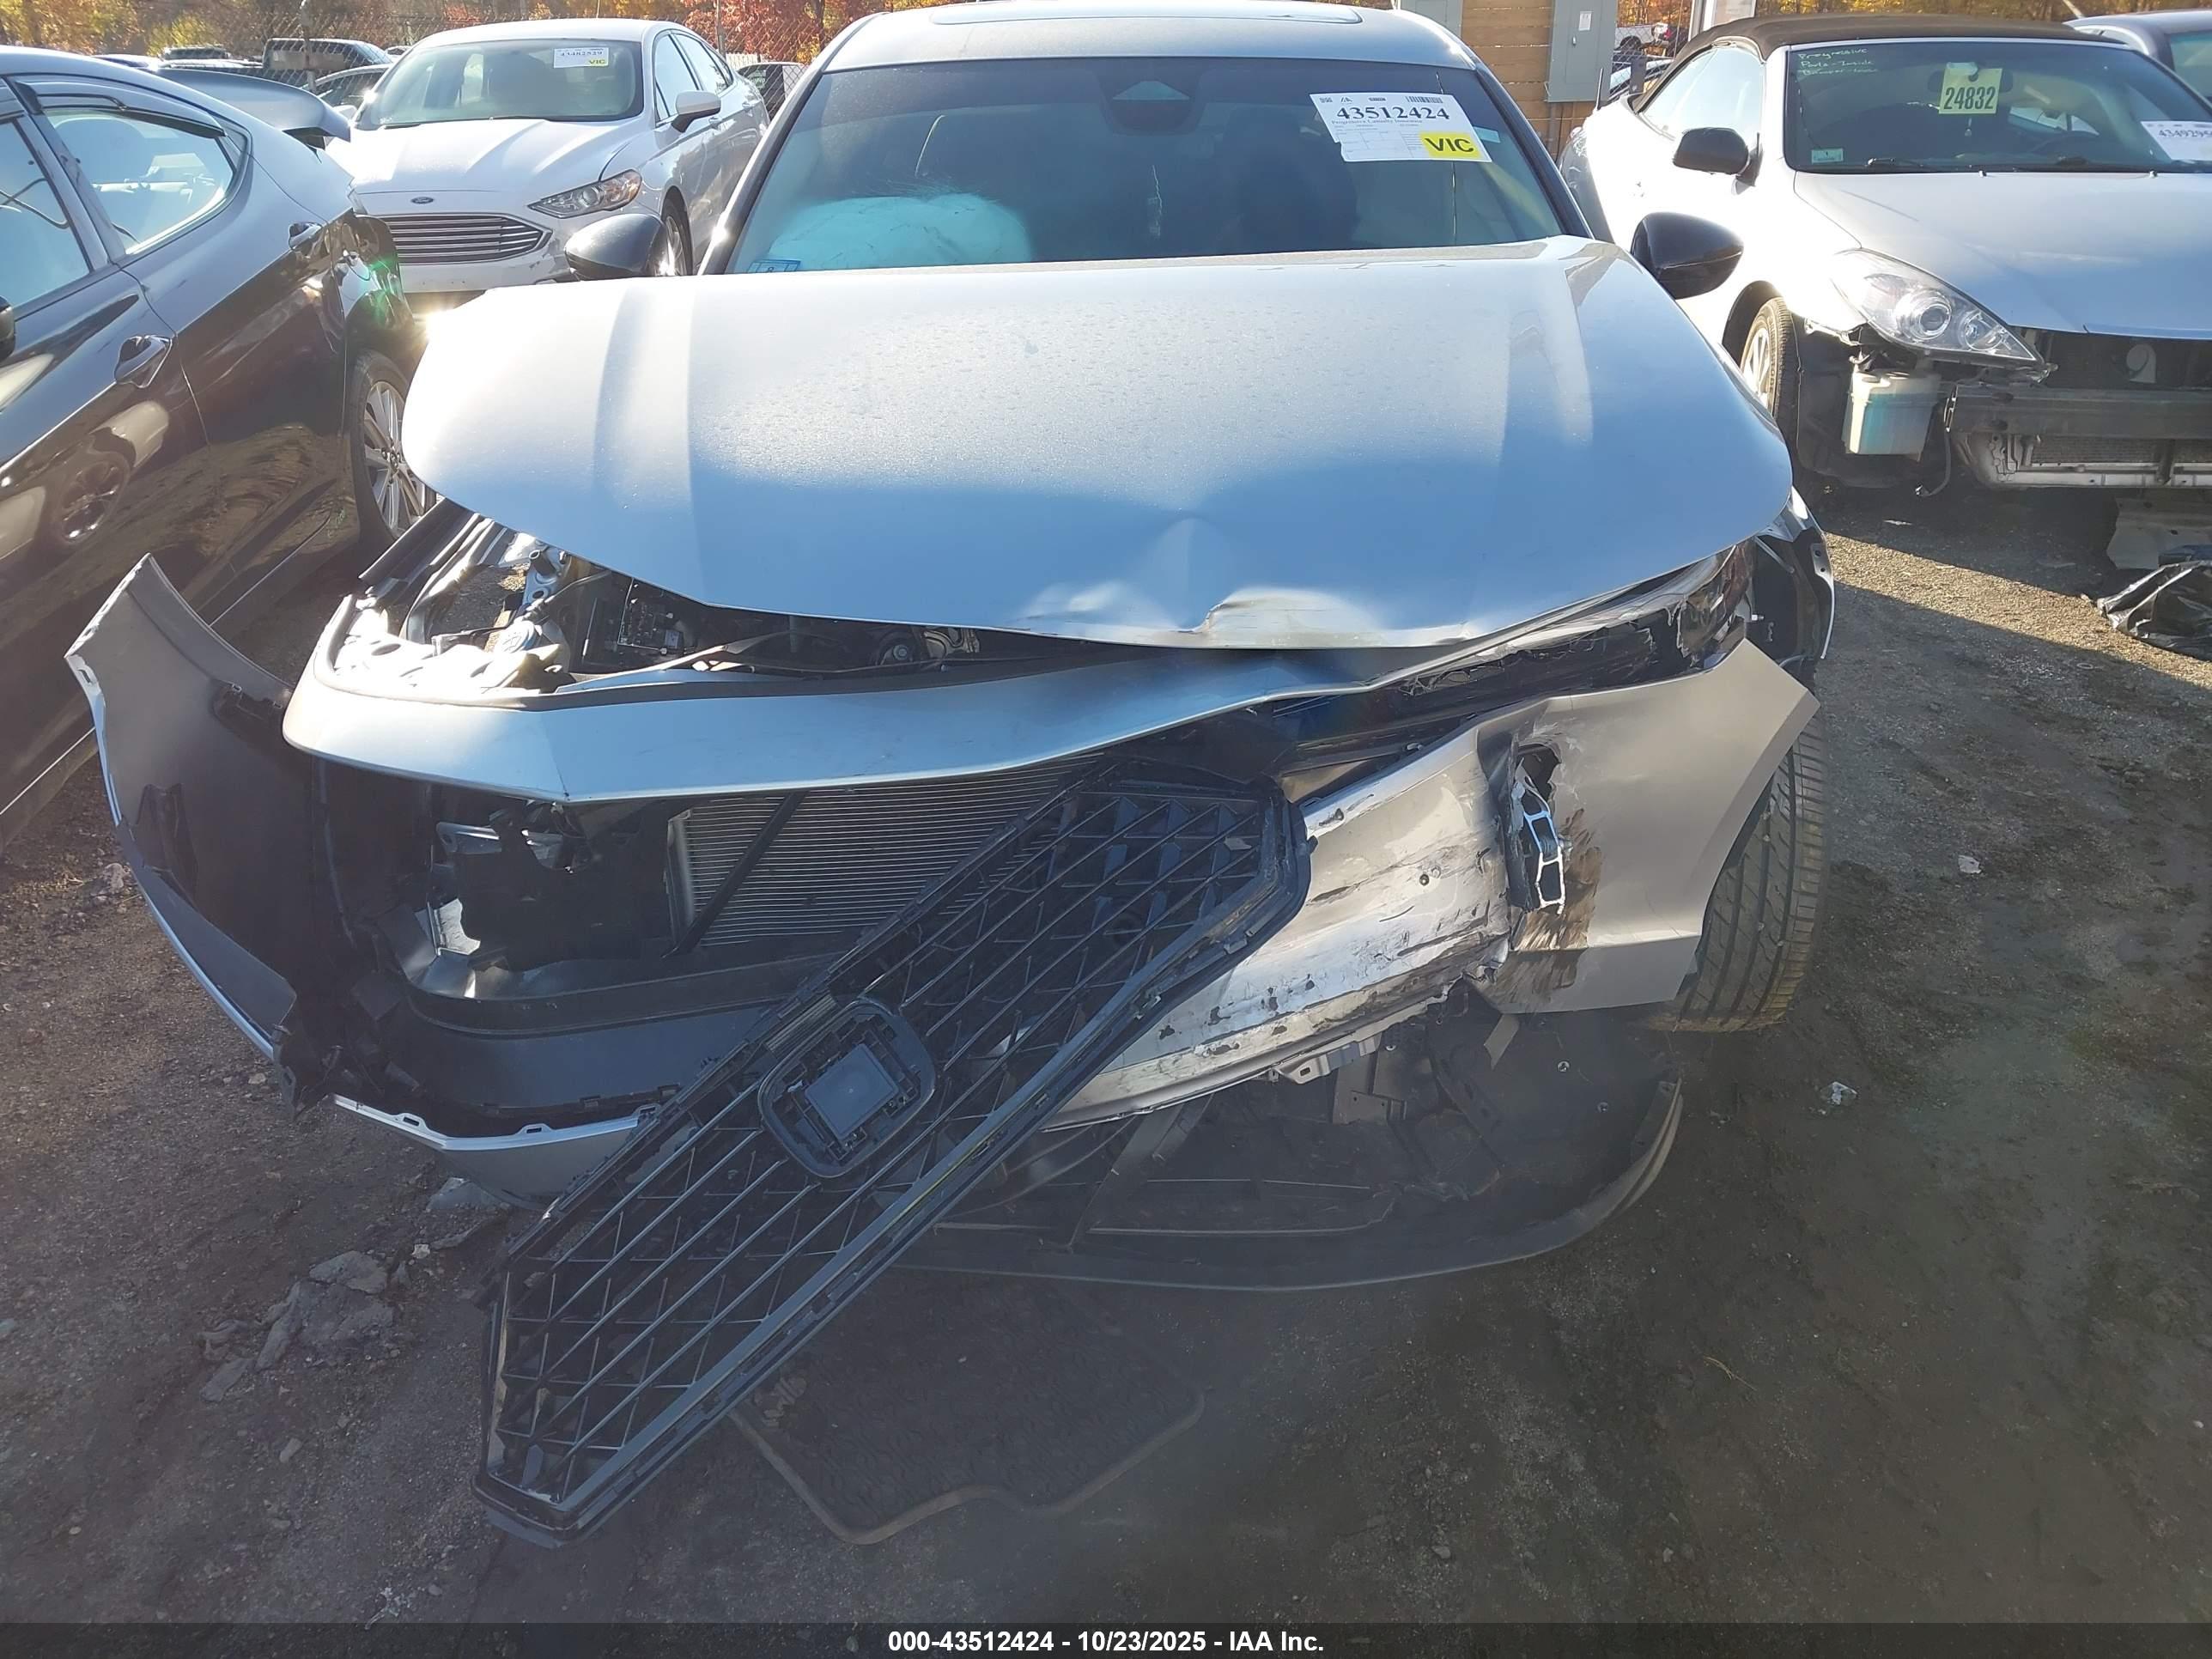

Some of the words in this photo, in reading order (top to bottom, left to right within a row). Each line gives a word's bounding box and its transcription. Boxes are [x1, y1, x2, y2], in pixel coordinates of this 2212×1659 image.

[1944, 87, 1996, 110] 24832
[1337, 106, 1449, 119] 43512424
[1425, 137, 1474, 152] VIC
